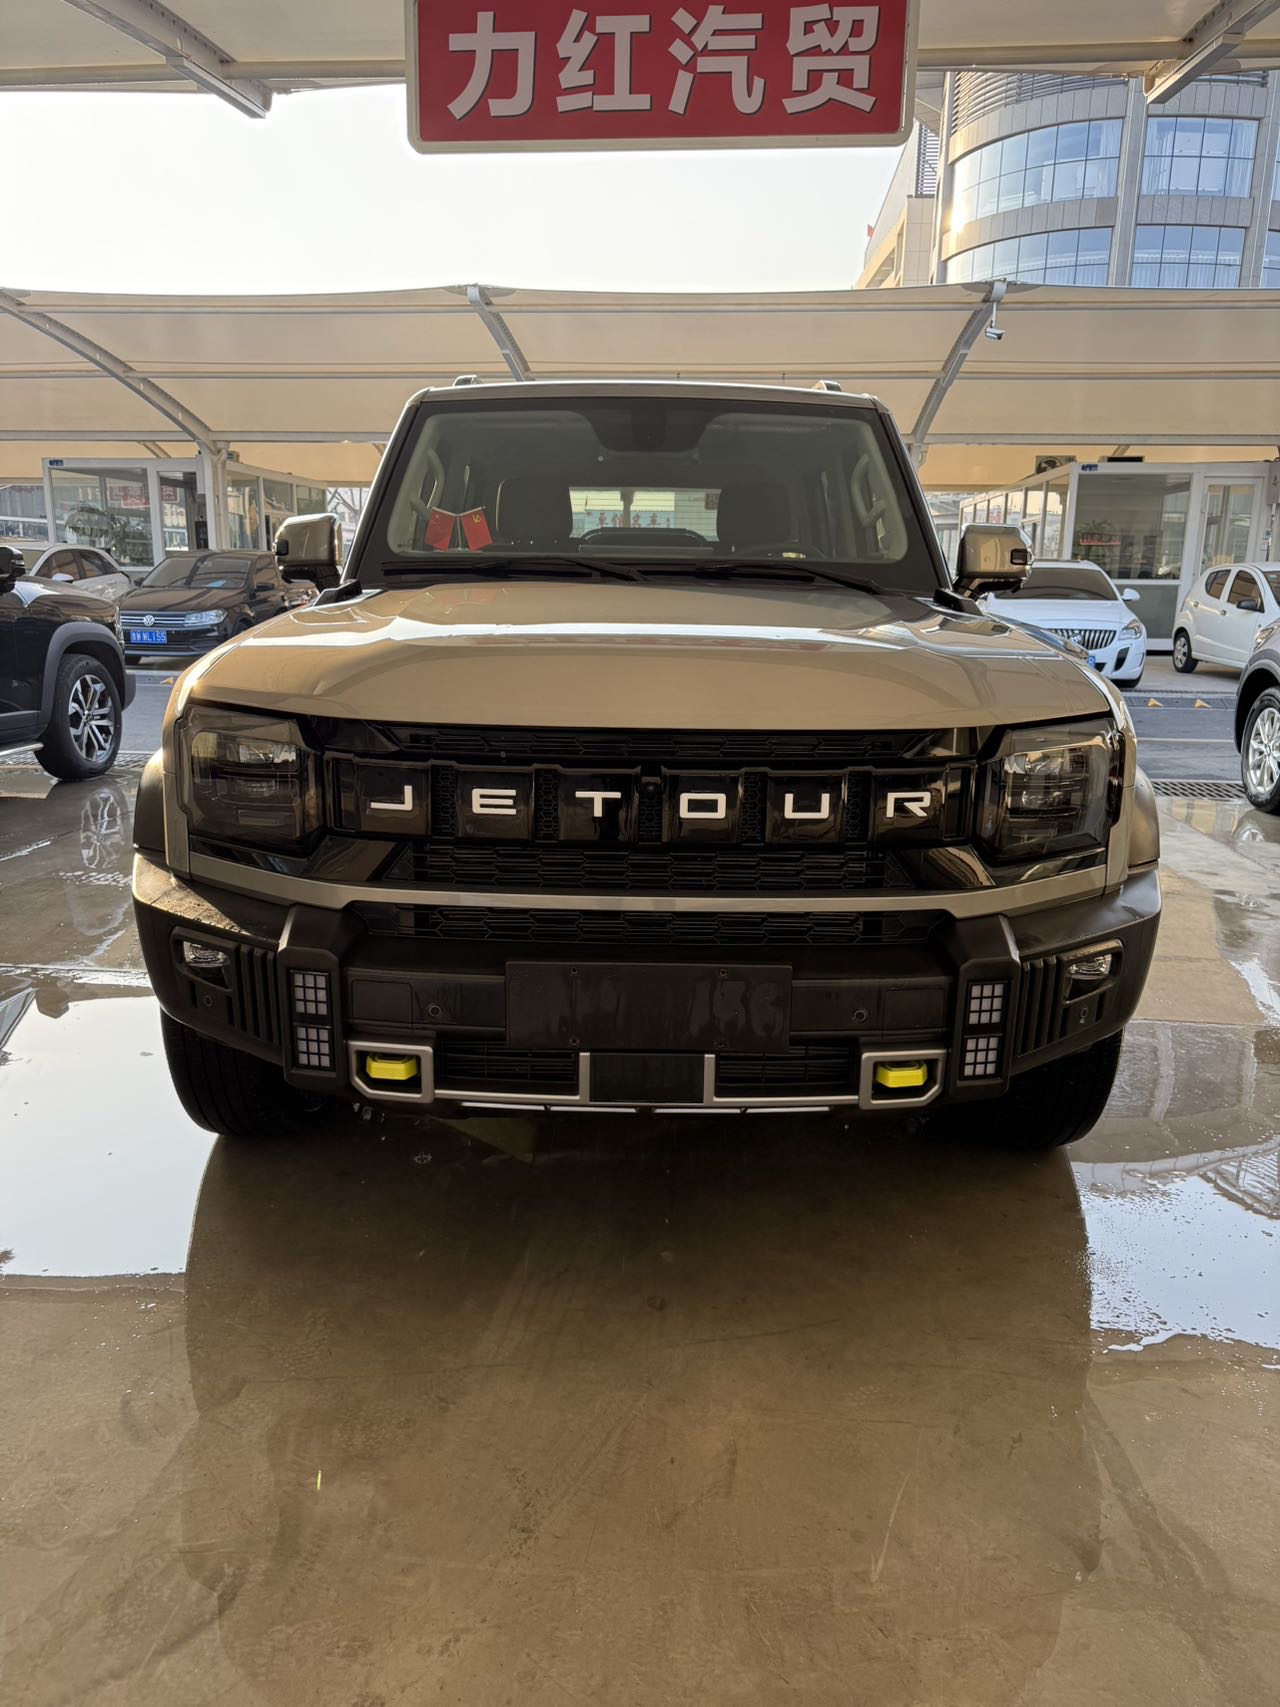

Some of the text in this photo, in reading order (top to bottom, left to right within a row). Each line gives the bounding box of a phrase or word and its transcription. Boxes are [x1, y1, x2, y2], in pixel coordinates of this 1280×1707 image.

[447, 3, 879, 120] 力红汽贸
[370, 785, 931, 819] JETOUR
